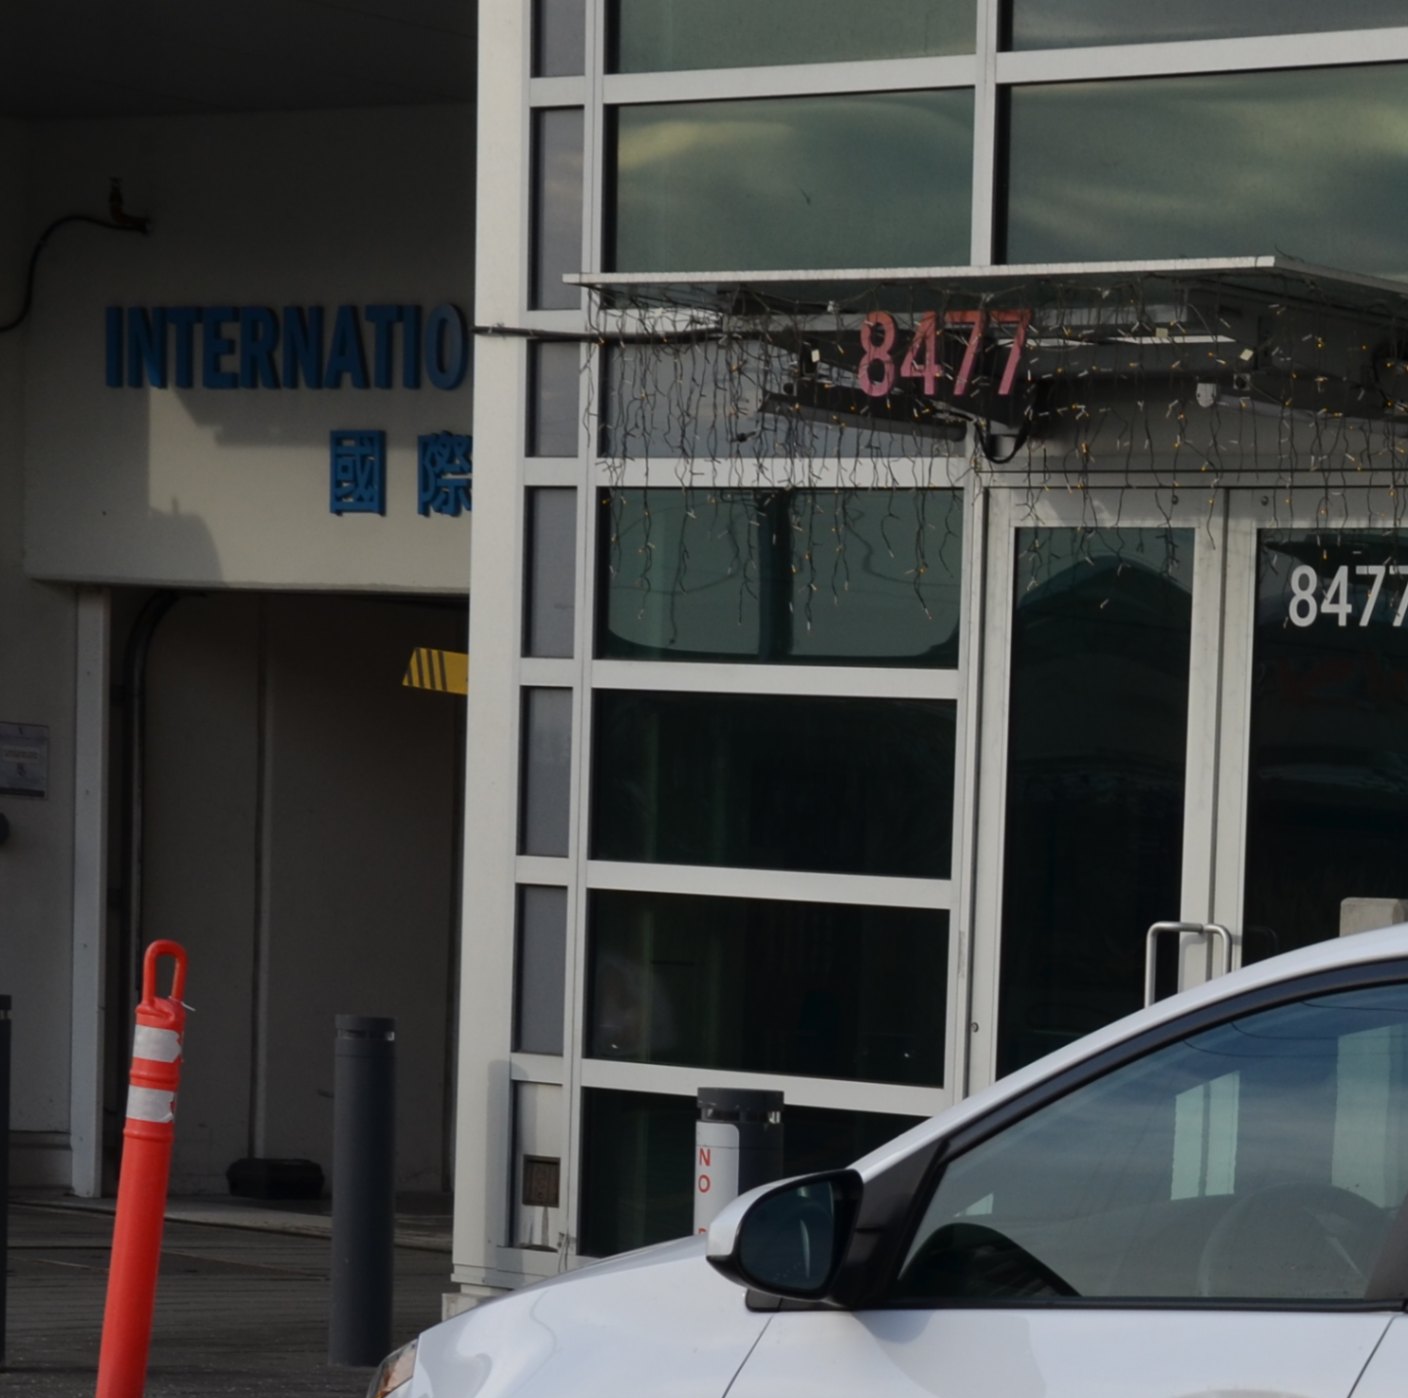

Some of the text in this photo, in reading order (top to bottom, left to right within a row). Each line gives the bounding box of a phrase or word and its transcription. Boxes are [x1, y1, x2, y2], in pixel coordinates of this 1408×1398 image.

[104, 304, 471, 391] INTERNATIO
[857, 309, 1033, 397] 8477
[698, 1148, 712, 1193] NO
